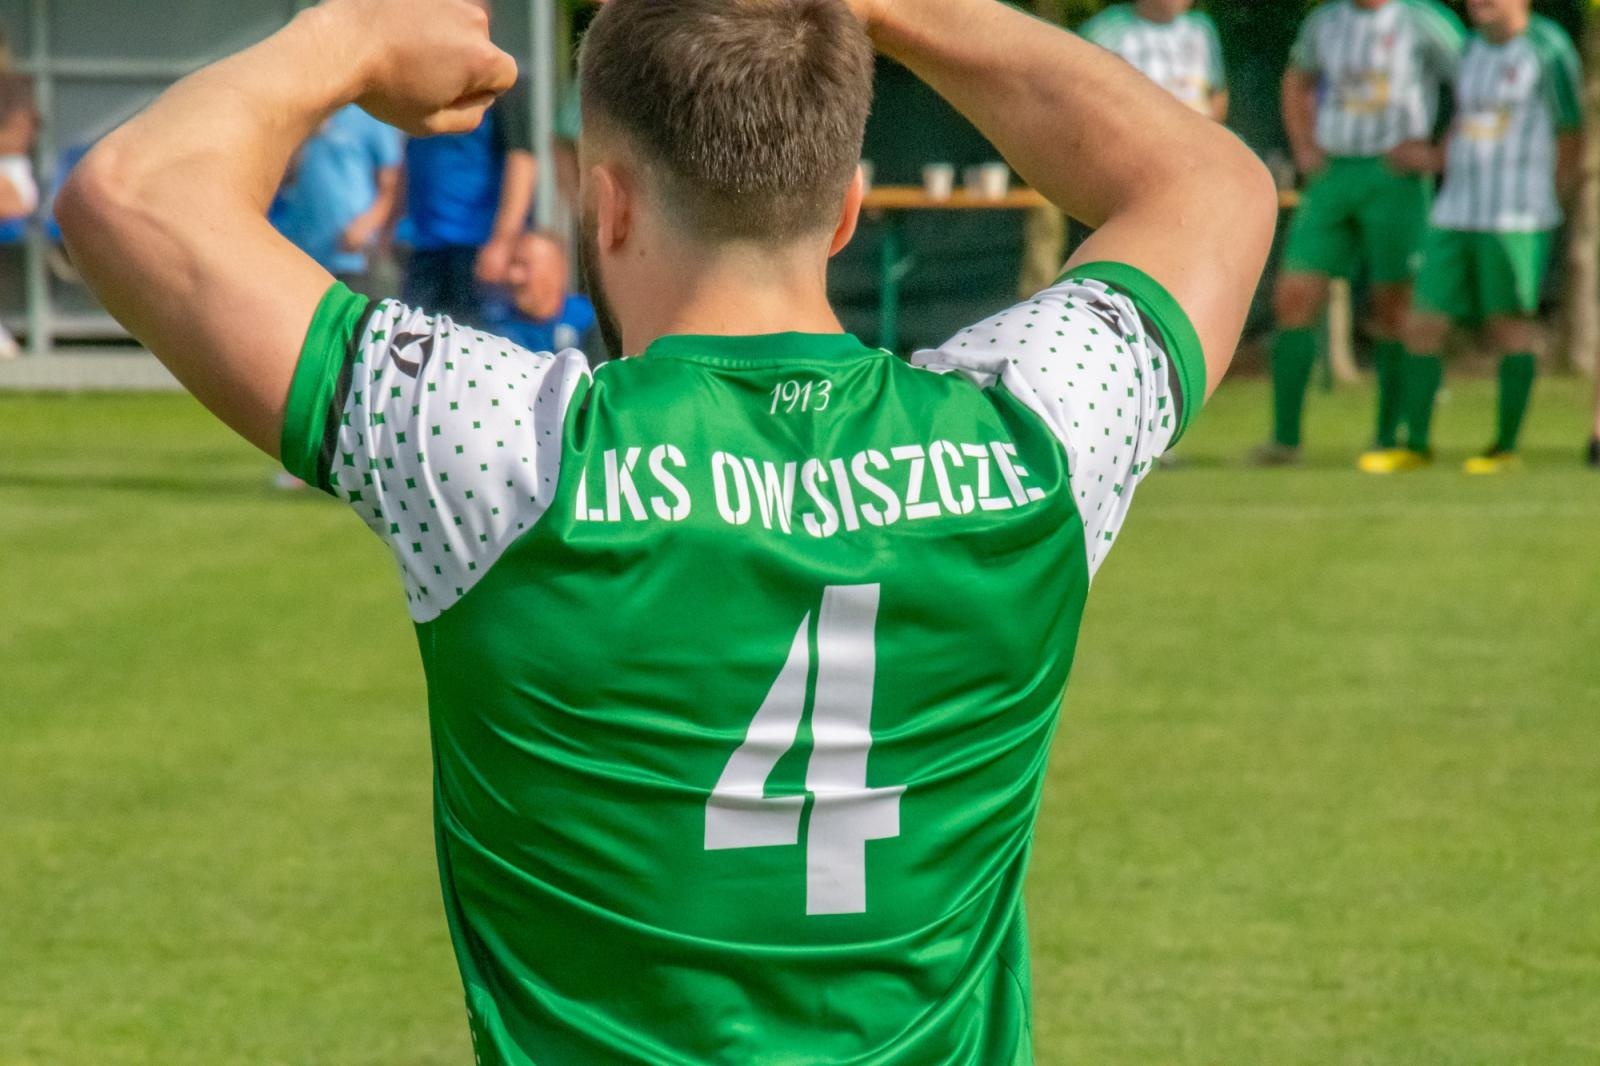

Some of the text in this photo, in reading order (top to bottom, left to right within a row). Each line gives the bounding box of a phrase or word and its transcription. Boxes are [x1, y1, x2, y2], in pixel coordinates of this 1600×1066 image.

[769, 379, 833, 416] 1913
[575, 439, 1046, 538] LKS OWSISZCZE
[704, 583, 906, 916] 4
